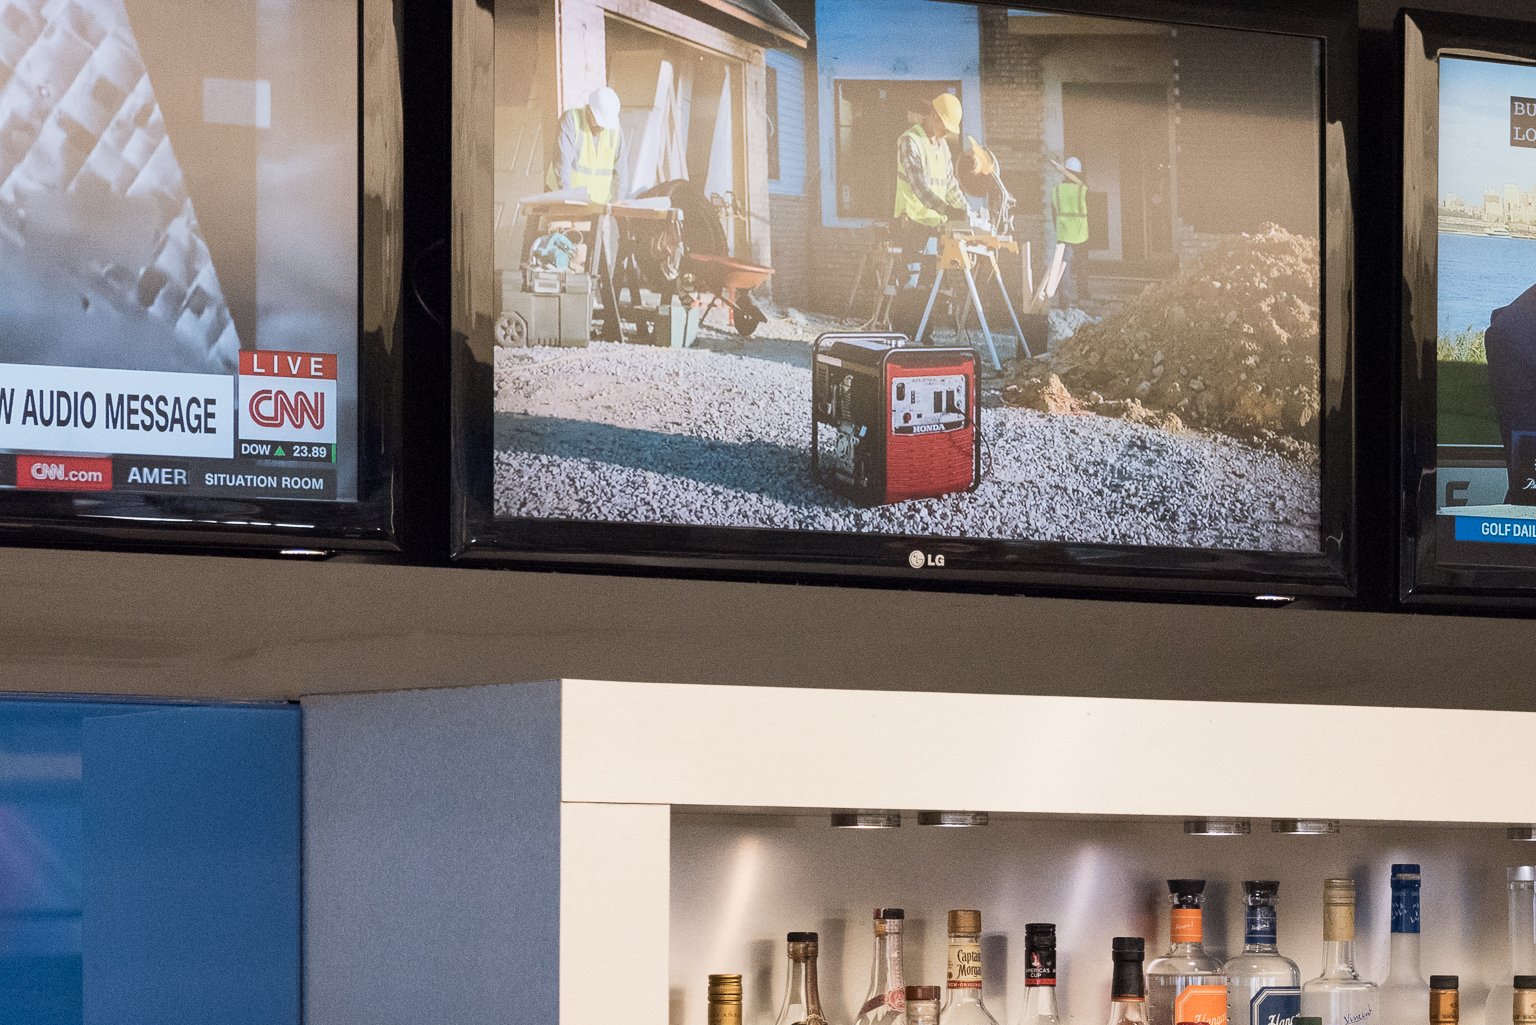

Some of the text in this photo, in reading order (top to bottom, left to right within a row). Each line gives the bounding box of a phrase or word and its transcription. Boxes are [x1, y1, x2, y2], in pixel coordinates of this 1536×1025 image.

[252, 353, 324, 377] LIVE
[22, 388, 96, 429] AUDIO
[105, 393, 217, 434] MESSAGE
[248, 389, 326, 430] CNN
[912, 423, 946, 433] HONDA
[241, 443, 327, 458] DOW 23.89
[30, 462, 103, 483] CNN.com
[127, 467, 187, 486] AMER
[204, 472, 324, 490] SITUATION ROOM
[1481, 522, 1510, 536] GOLF
